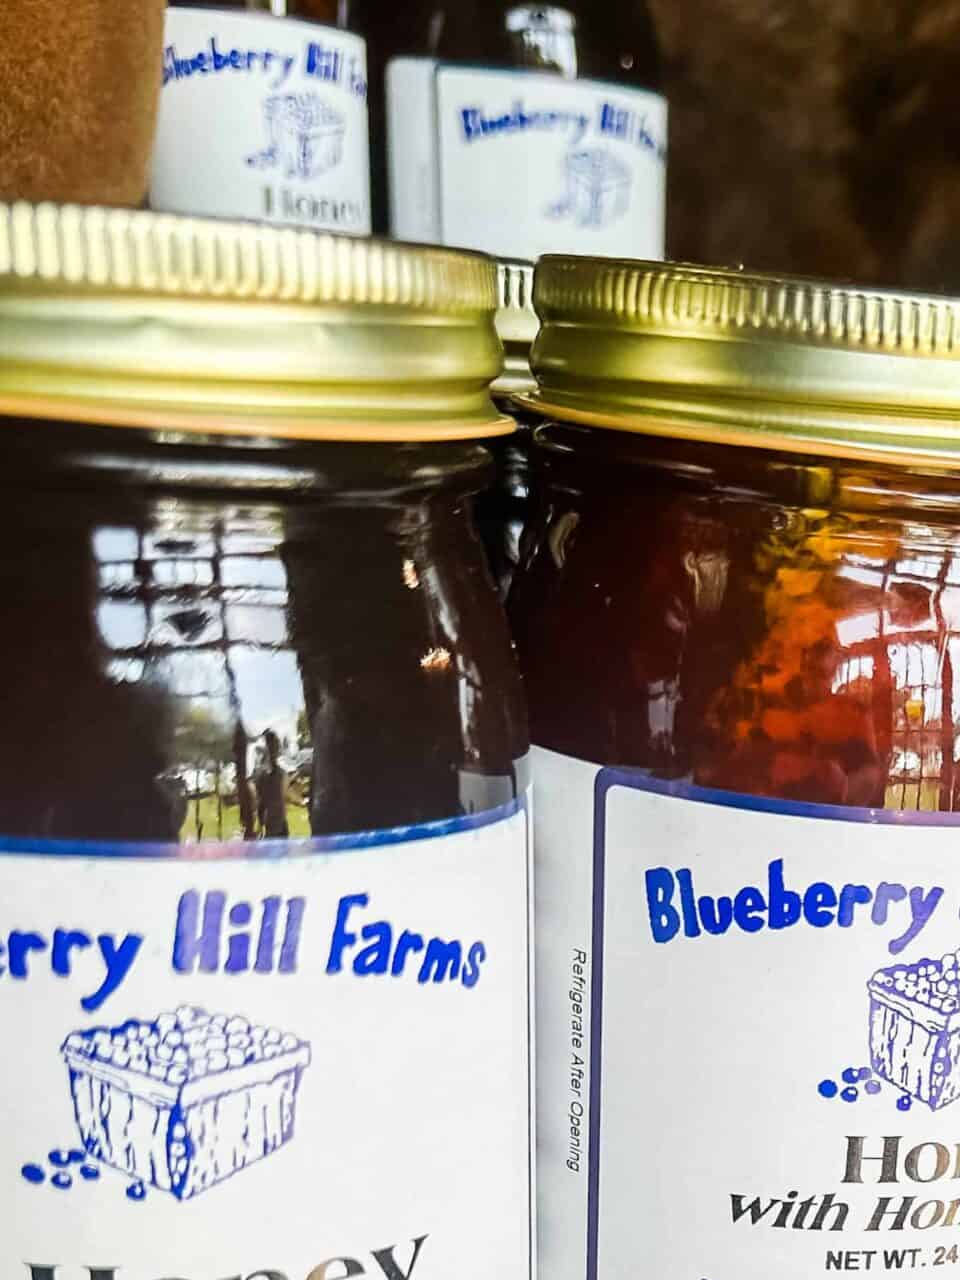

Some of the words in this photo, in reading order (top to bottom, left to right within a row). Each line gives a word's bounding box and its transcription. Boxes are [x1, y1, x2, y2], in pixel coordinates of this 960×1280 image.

[645, 857, 945, 955] Blueberry
[0, 926, 144, 1013] rry
[172, 888, 306, 976] Hill
[325, 892, 487, 988] Farms
[569, 948, 587, 1049] Refrigerate
[570, 1053, 585, 1097] After
[566, 1100, 584, 1173] Opening
[730, 1190, 850, 1231] with
[825, 1250, 877, 1270] NET
[884, 1249, 927, 1270] WT.
[933, 1245, 959, 1267] 24
